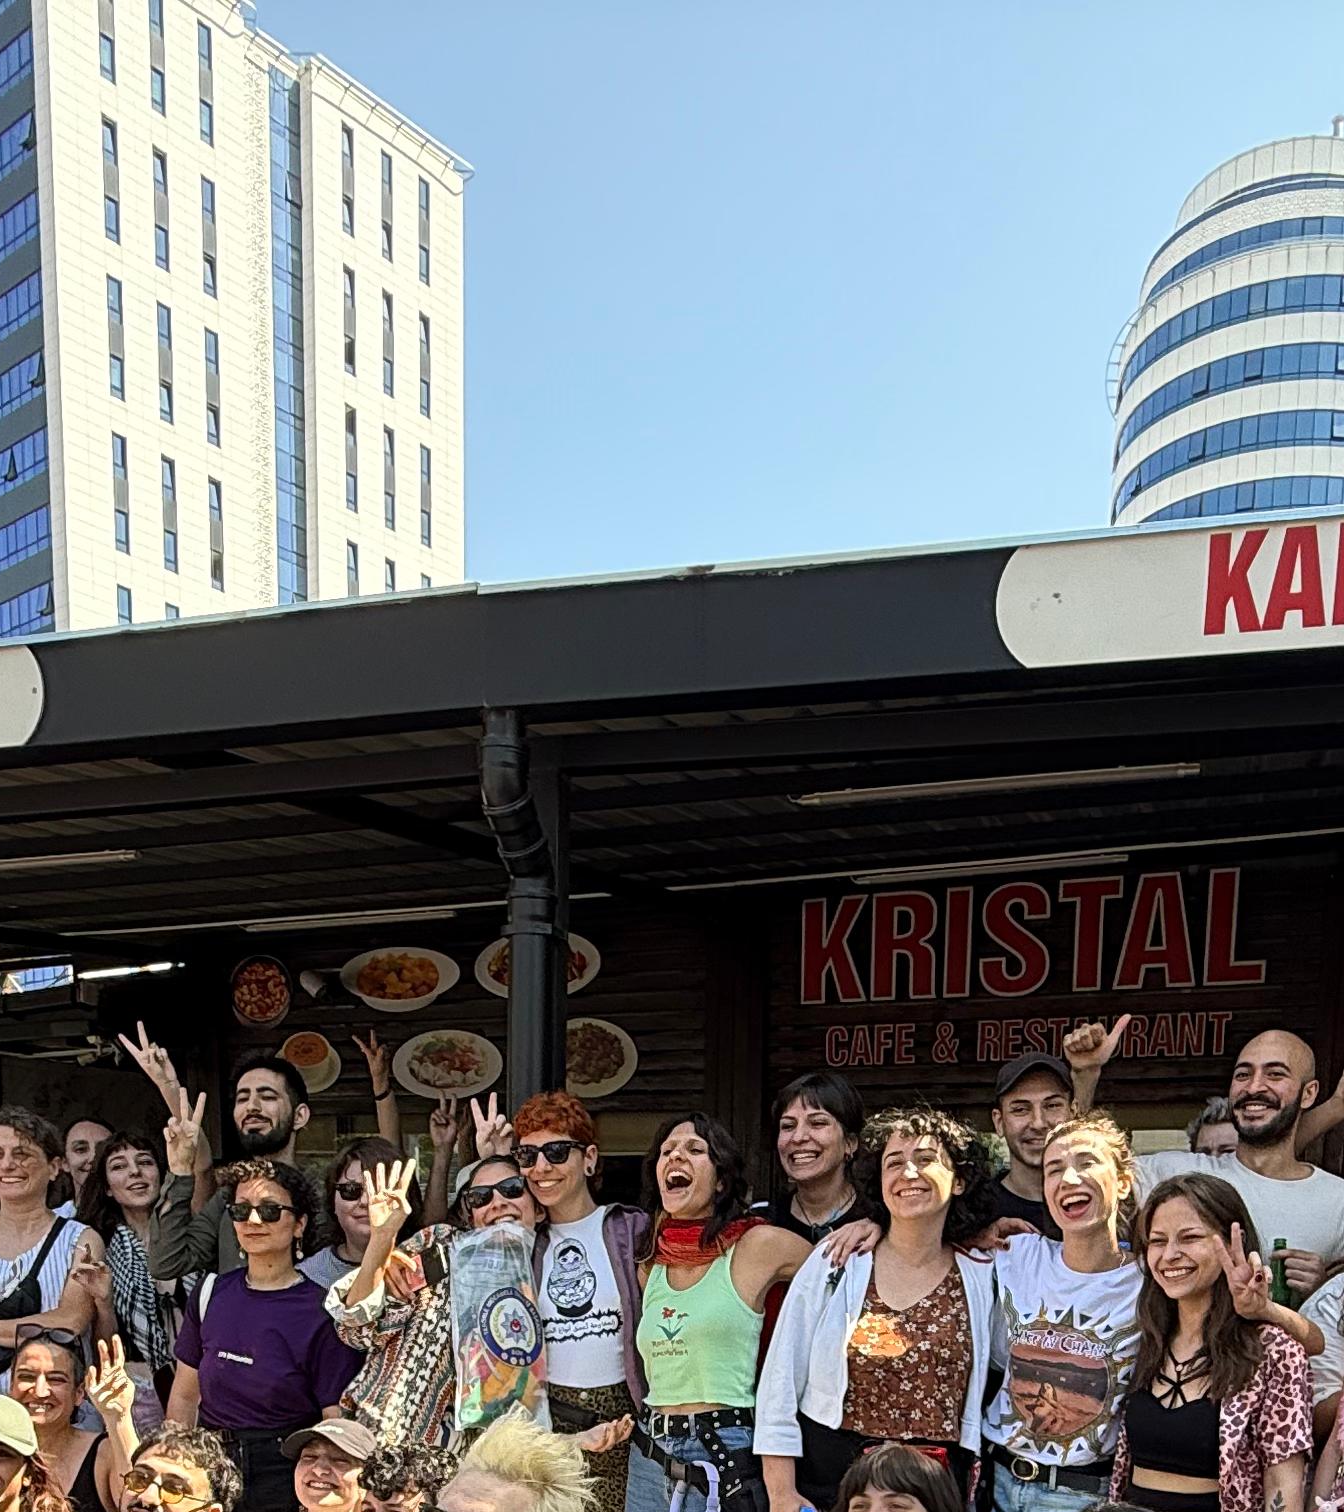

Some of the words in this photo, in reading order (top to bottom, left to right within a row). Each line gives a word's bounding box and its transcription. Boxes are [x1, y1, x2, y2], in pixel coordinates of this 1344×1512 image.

[800, 866, 1267, 1004] KRISTAL
[826, 1023, 916, 1066] CAFE
[931, 1021, 958, 1063] &
[977, 1011, 1233, 1063] RESTRANT
